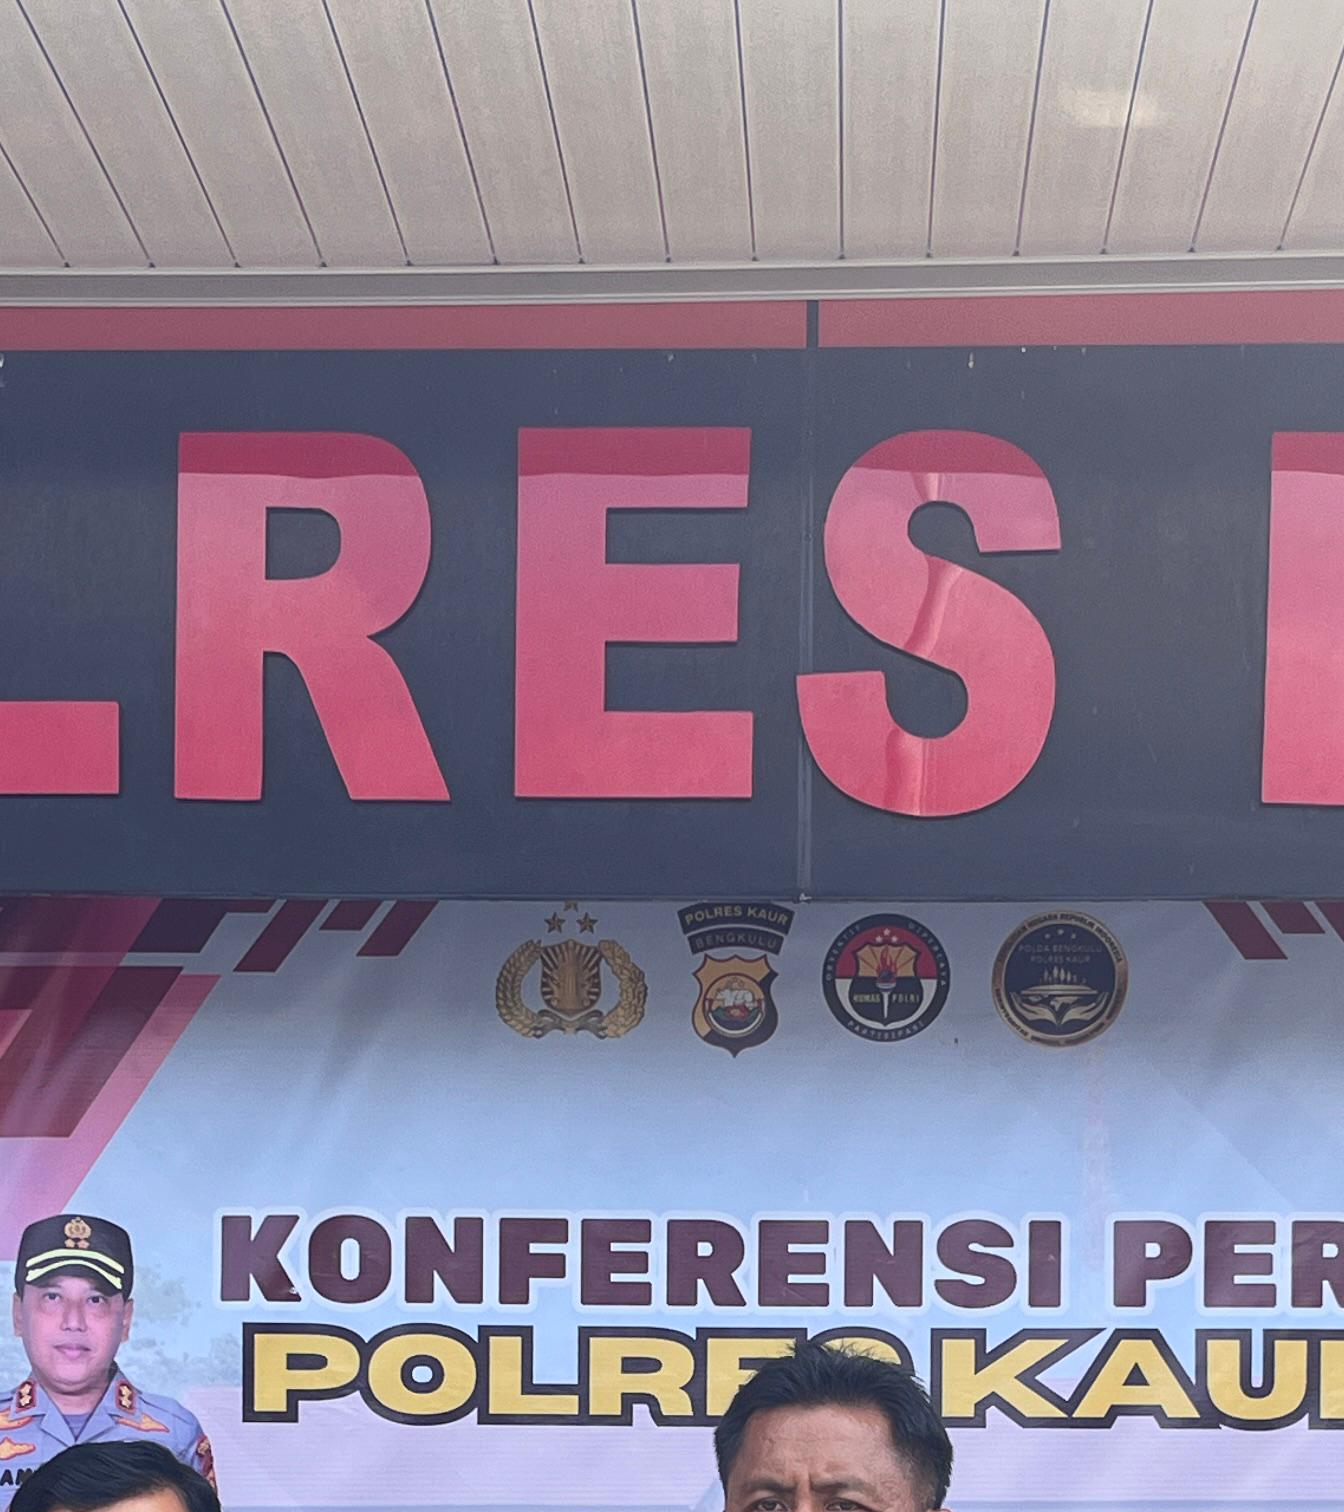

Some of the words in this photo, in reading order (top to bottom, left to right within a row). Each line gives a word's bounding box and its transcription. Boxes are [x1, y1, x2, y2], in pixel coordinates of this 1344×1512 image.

[684, 905, 743, 925] POLRES
[747, 905, 789, 926] KAUR
[696, 931, 777, 950] BENGKULU
[218, 1213, 1064, 1310] KONFERENSI
